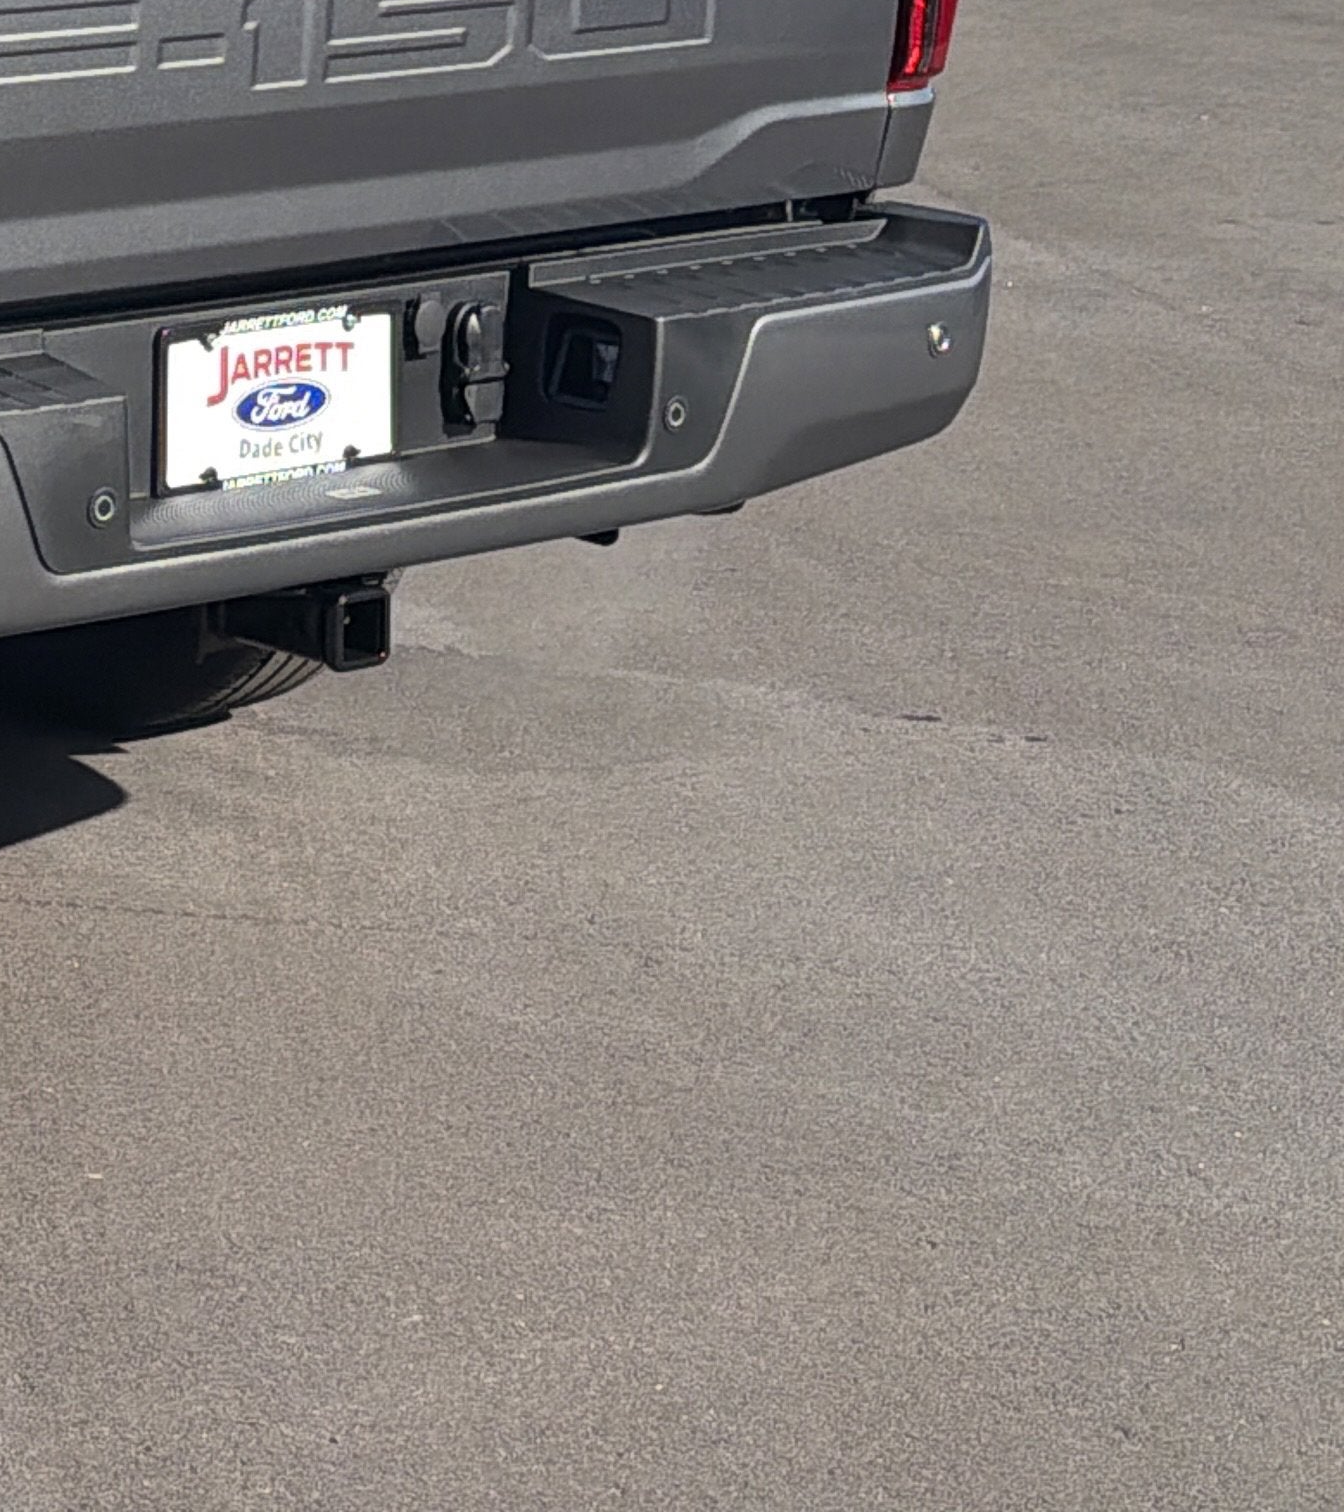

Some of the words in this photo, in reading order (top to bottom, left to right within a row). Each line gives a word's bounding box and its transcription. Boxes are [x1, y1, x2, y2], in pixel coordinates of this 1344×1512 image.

[207, 341, 355, 407] JARRETT
[250, 385, 313, 425] Ford
[239, 436, 284, 459] Dade
[288, 430, 325, 454] City
